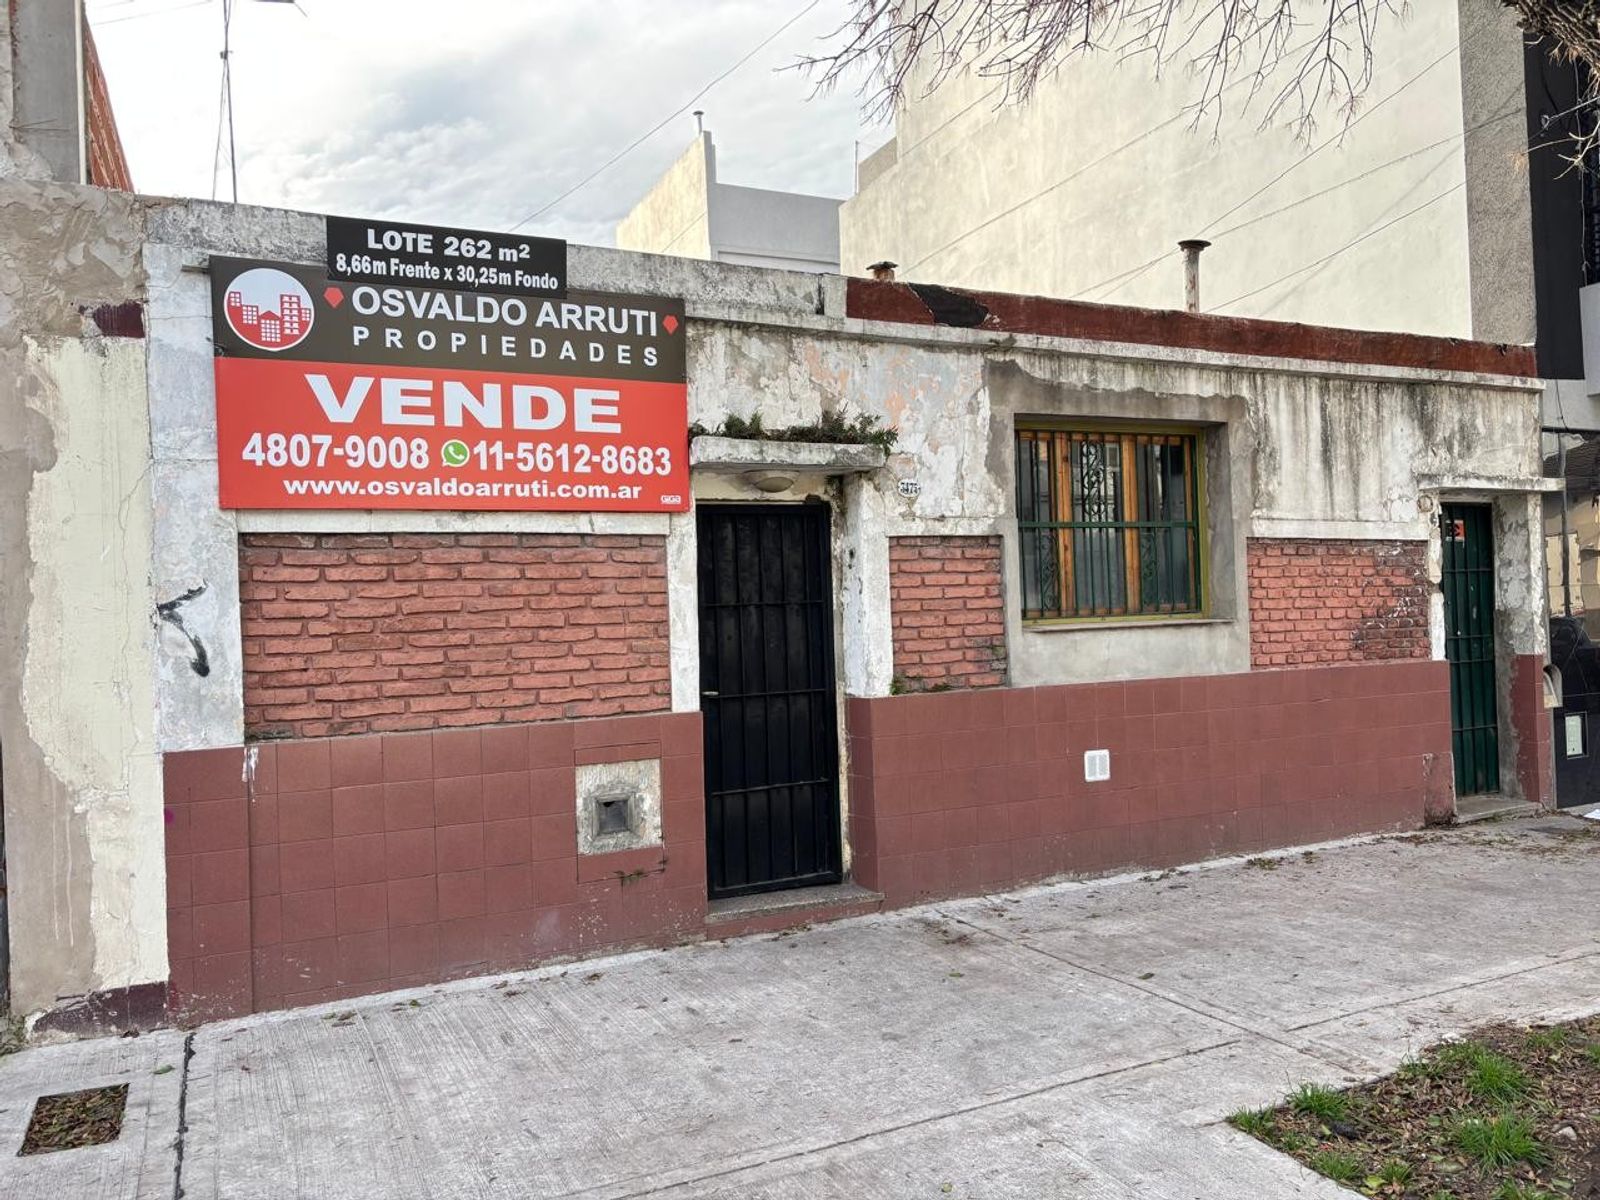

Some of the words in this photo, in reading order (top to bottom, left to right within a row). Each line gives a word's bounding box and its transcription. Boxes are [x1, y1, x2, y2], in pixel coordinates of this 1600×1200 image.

[367, 228, 433, 254] LOTE
[443, 235, 492, 260] 262
[336, 253, 386, 276] 8,66m
[390, 257, 440, 281] Frente
[443, 267, 453, 281] x
[456, 264, 512, 288] 30,25m
[515, 269, 559, 290] Fondo
[352, 286, 527, 326] OSVALDO
[535, 301, 658, 337] ARRUTI
[353, 325, 658, 367] PROPIEDADES
[304, 373, 622, 434] VENDE
[241, 432, 429, 469] 4807-9008
[473, 440, 672, 476] 11-5612-8683
[282, 477, 642, 499] www.osvaldoarruti.com.ar
